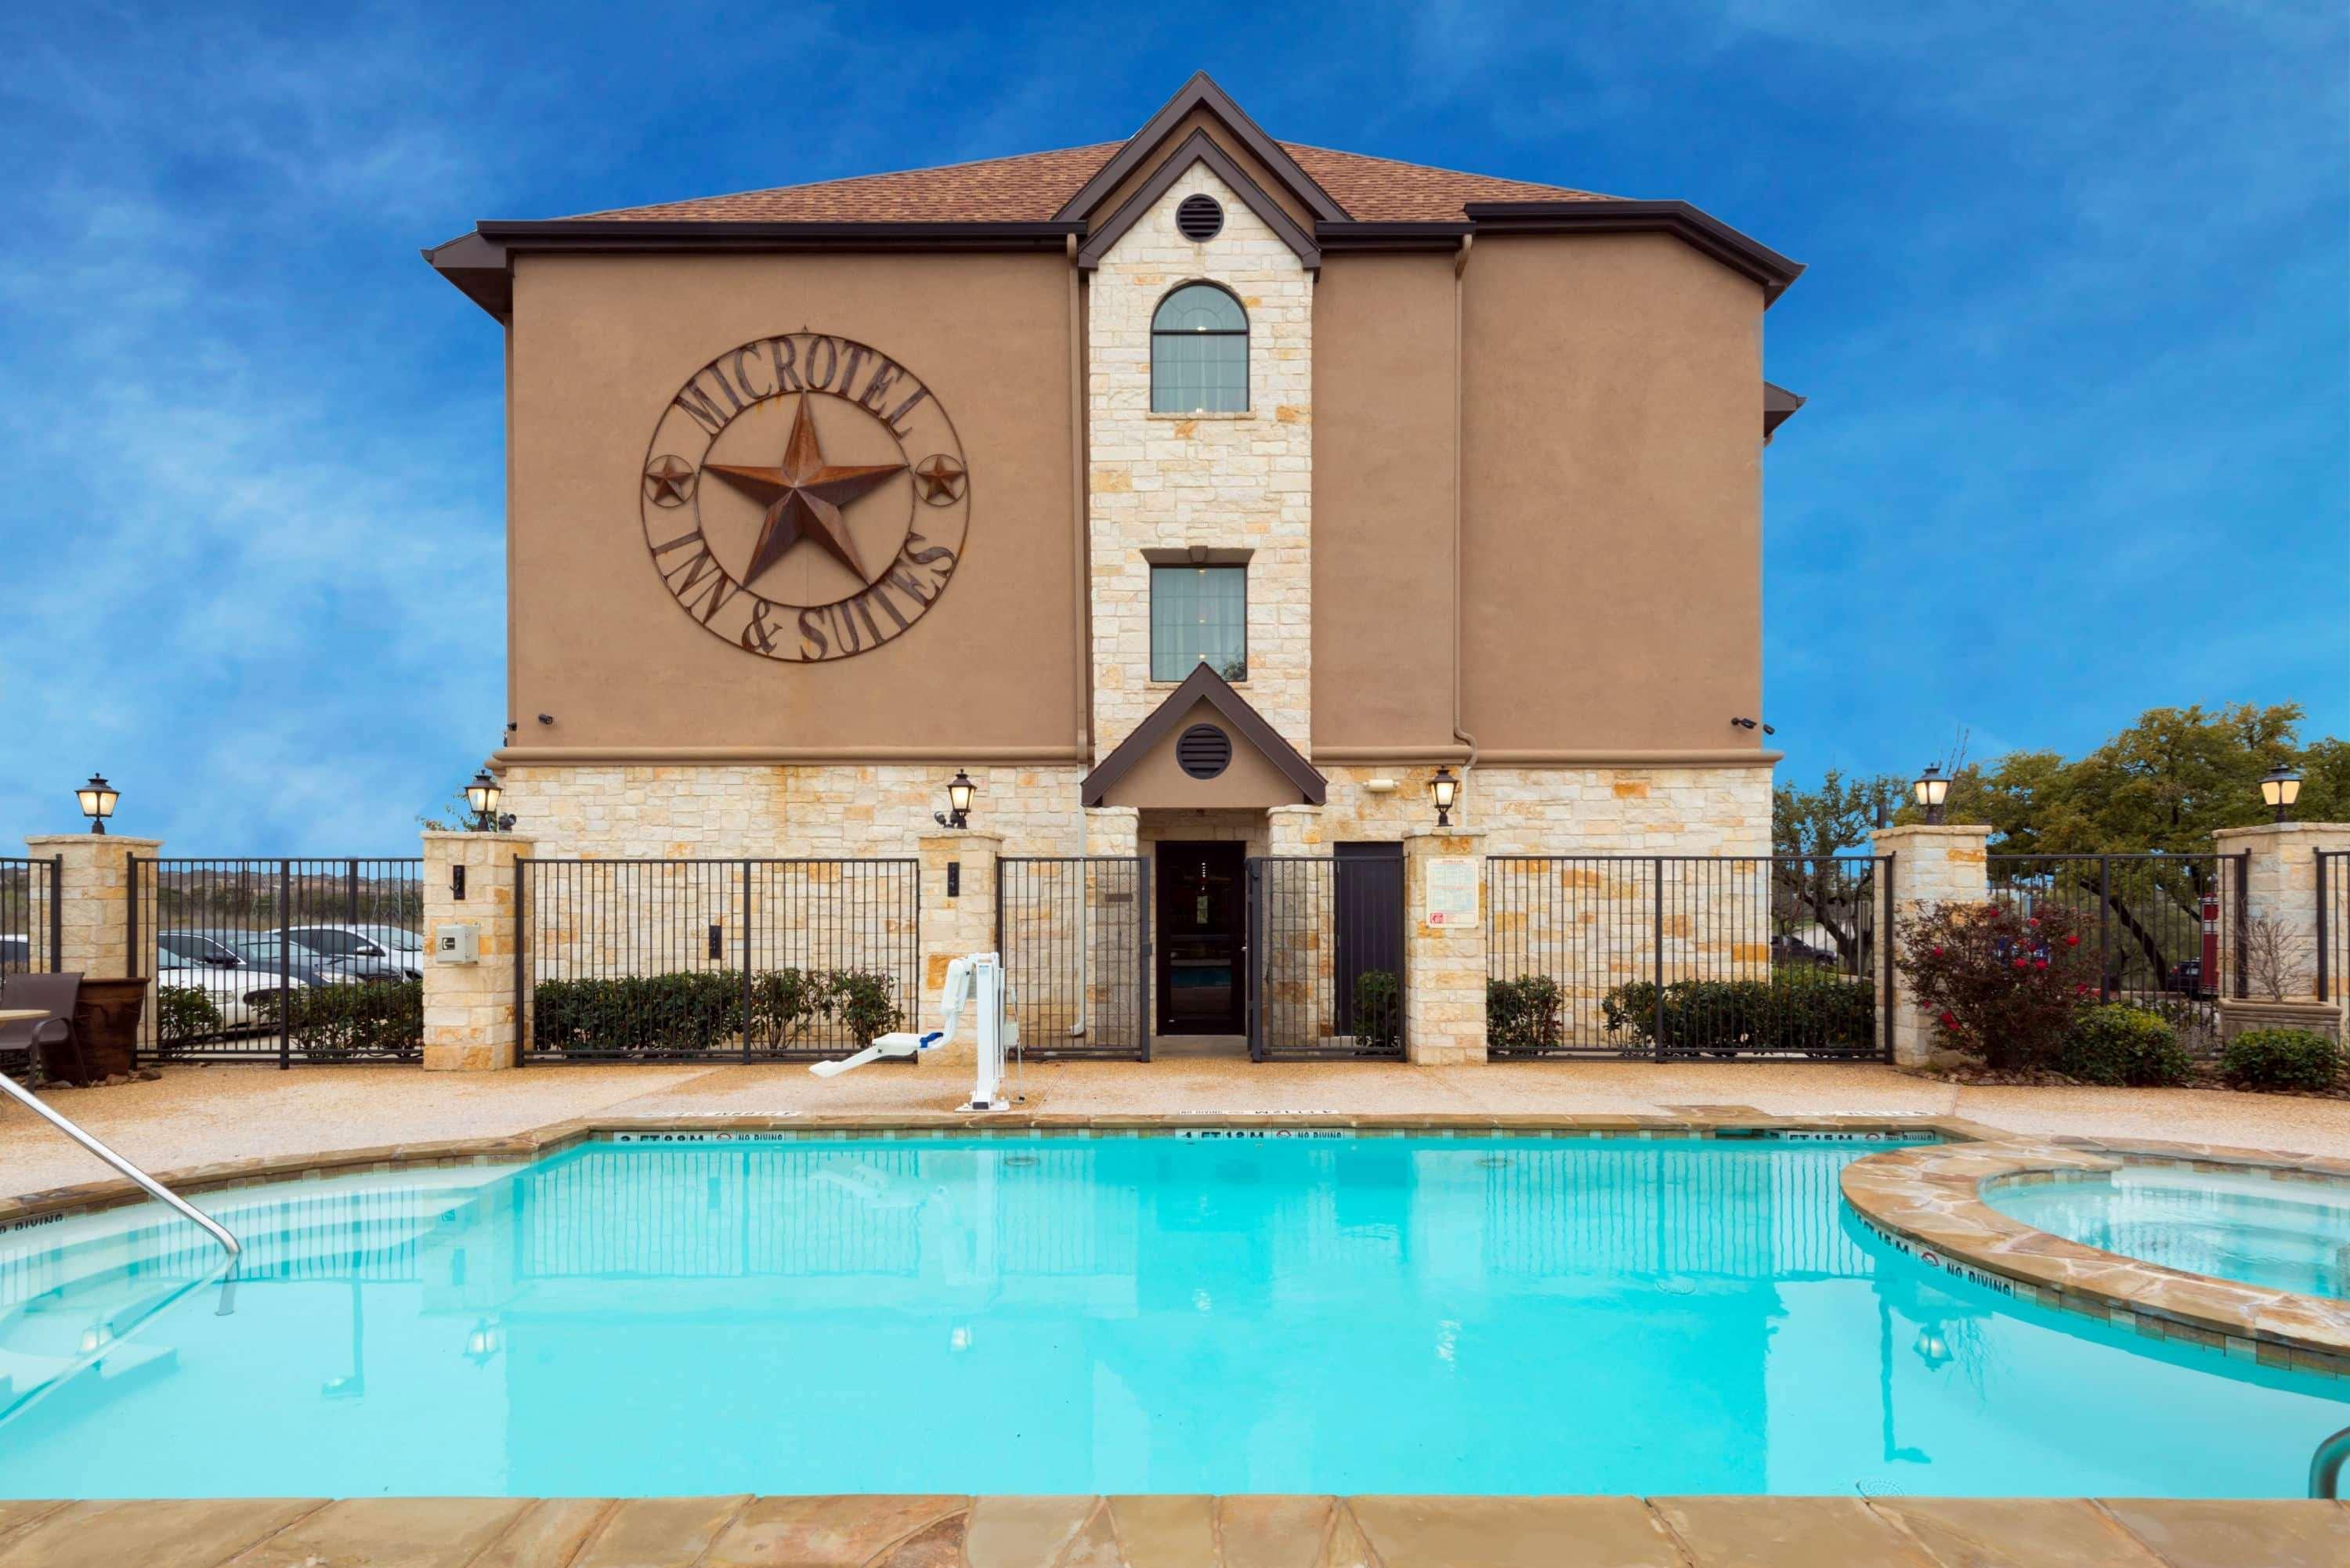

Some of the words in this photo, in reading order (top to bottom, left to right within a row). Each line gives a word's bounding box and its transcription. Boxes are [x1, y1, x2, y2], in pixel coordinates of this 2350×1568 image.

[672, 336, 931, 442] MICROTEL
[652, 526, 742, 625] INN
[741, 600, 783, 653] &
[798, 531, 958, 663] SUITES
[15, 1213, 63, 1231] DIVING
[1946, 1262, 1963, 1279] NO
[1968, 1270, 2012, 1297] DIVING
